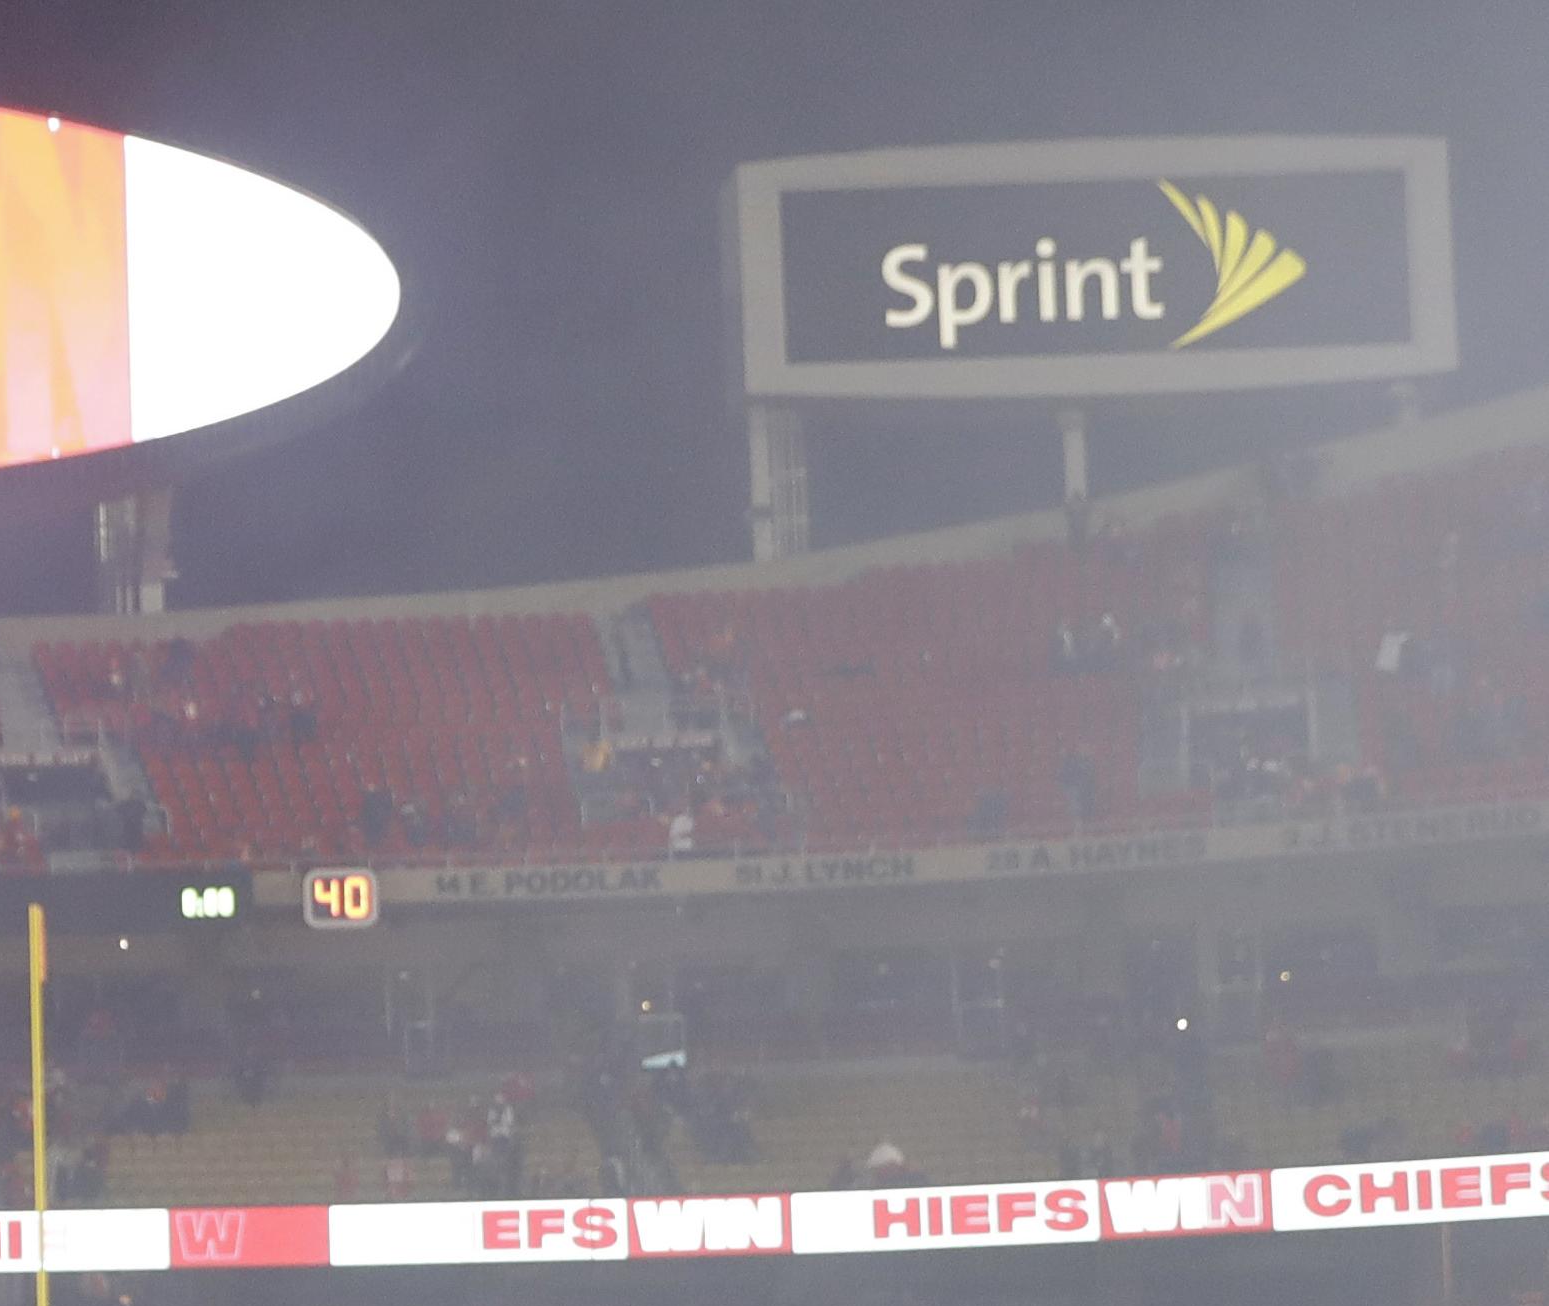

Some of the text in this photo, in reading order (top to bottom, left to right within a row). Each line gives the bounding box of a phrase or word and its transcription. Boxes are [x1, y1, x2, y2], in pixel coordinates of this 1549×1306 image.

[880, 237, 1165, 350] Sprint
[804, 856, 916, 882] LYNCH
[313, 875, 371, 920] 40
[481, 1206, 619, 1250] EFS
[632, 1196, 783, 1253] WIN
[872, 1188, 1090, 1239] HIEFS
[1103, 1172, 1264, 1234] WIN
[175, 1210, 247, 1261] W
